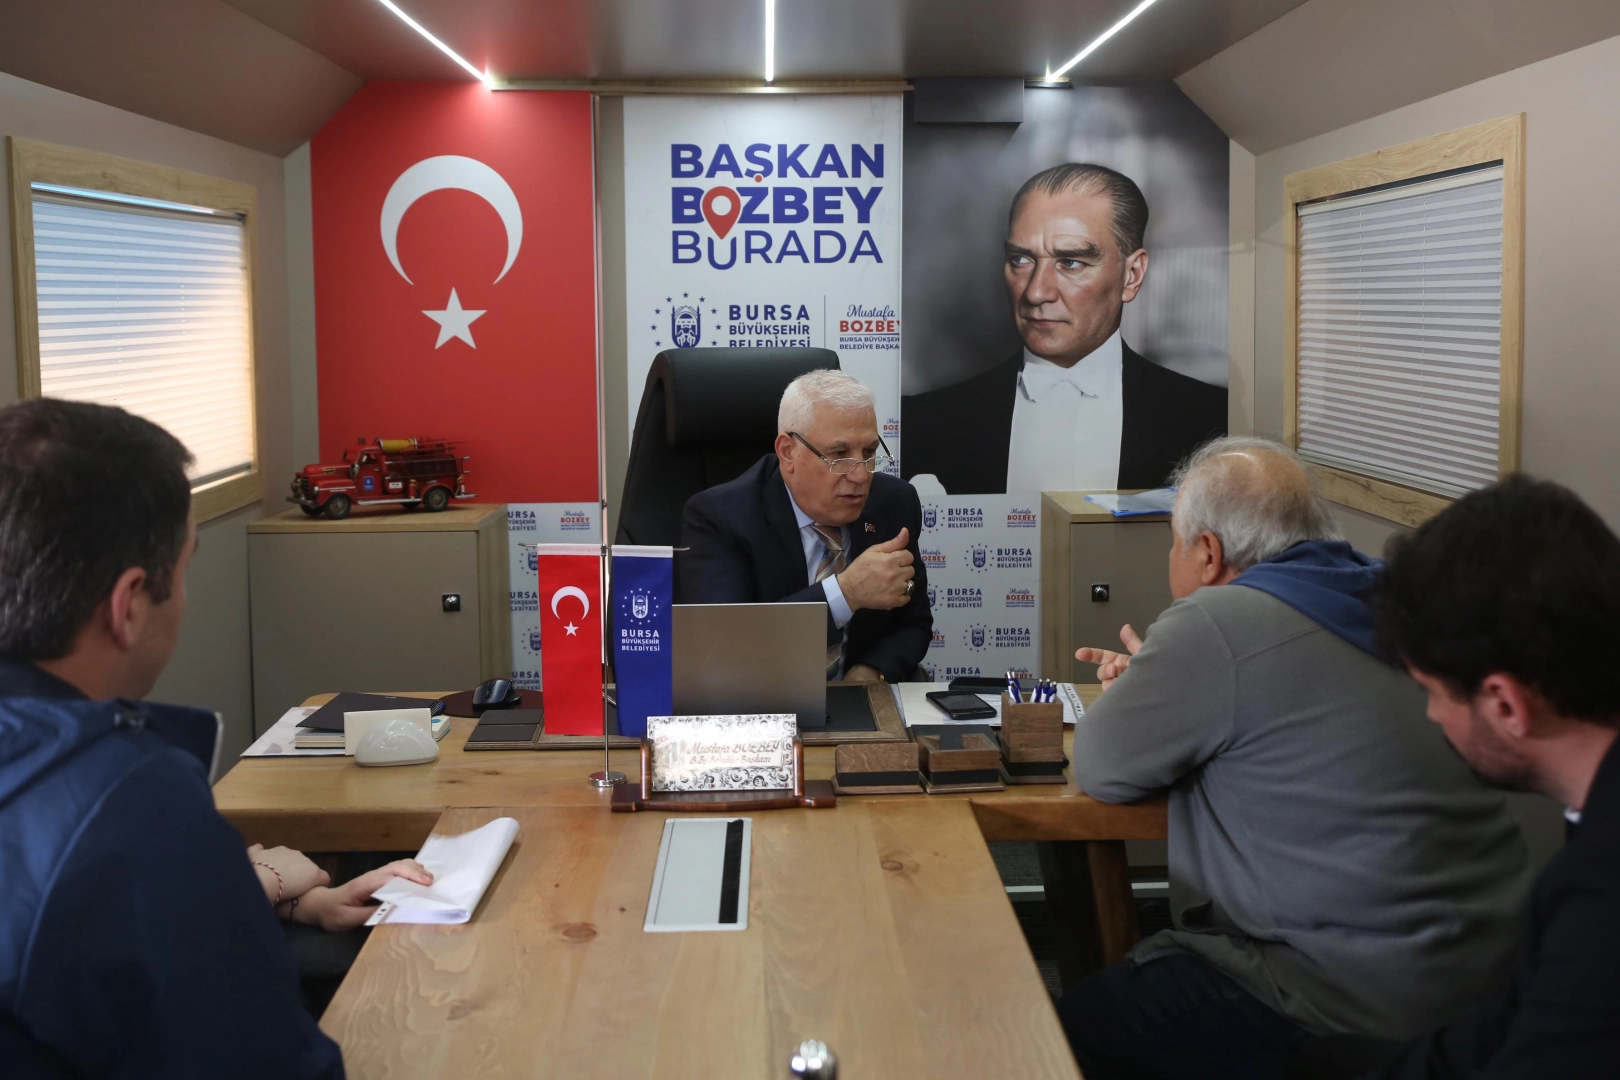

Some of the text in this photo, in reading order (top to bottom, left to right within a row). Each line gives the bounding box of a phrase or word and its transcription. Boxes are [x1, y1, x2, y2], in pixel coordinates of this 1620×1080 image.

[671, 143, 884, 183] BAŞKAN
[672, 230, 884, 271] BURADA
[729, 304, 811, 321] BURSA
[847, 304, 896, 321] Mustafa
[729, 322, 810, 337] BÜYÜKŞEHİR
[840, 320, 899, 333] BOZBE
[864, 335, 900, 343] BÜYÜKŞEH
[875, 343, 900, 351] BAŞKA
[507, 511, 536, 519] URSA
[948, 508, 983, 516] BURSA
[997, 548, 1032, 556] BURSA
[510, 591, 538, 599] URSA
[947, 588, 982, 596] BURSA
[621, 629, 660, 638] BURSA
[996, 627, 1030, 635] BURSA
[621, 637, 660, 645] BÜYÜKŞEHİR
[621, 644, 660, 652] BELEDİYESİ
[512, 671, 540, 679] URSA
[946, 667, 981, 675] BURSA
